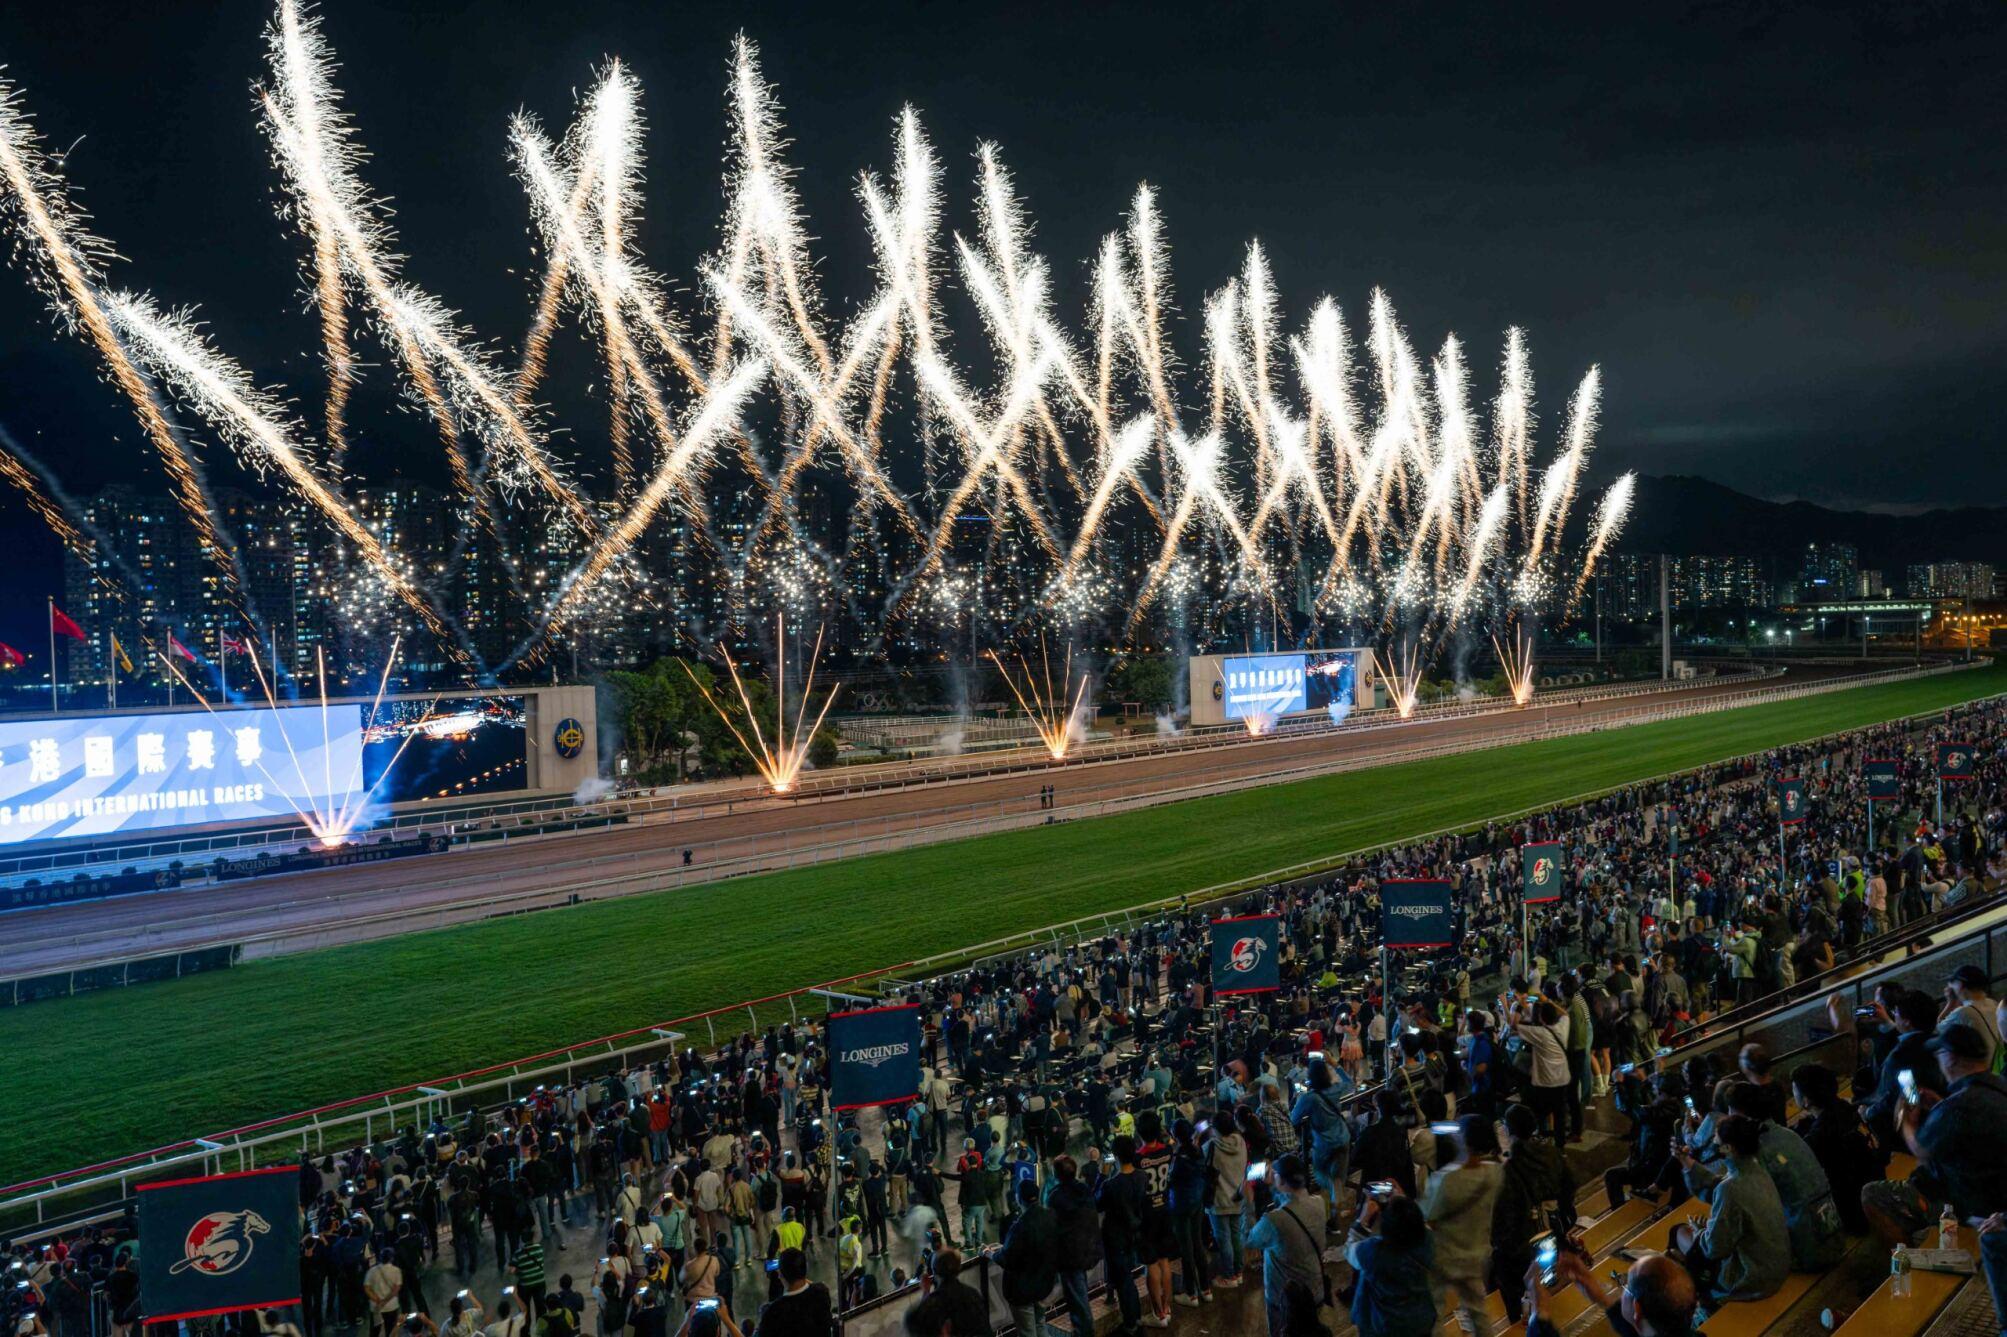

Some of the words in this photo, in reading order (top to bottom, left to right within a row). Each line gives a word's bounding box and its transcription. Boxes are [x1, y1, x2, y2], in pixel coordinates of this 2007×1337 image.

[19, 801, 69, 824] KONG
[74, 788, 208, 818] INTERNATIONAL
[214, 783, 263, 804] RACES
[221, 859, 281, 874] LONGINES
[1390, 905, 1443, 915] LONGINES
[841, 1042, 909, 1063] LONGINES
[1144, 1164, 1169, 1195] 38
